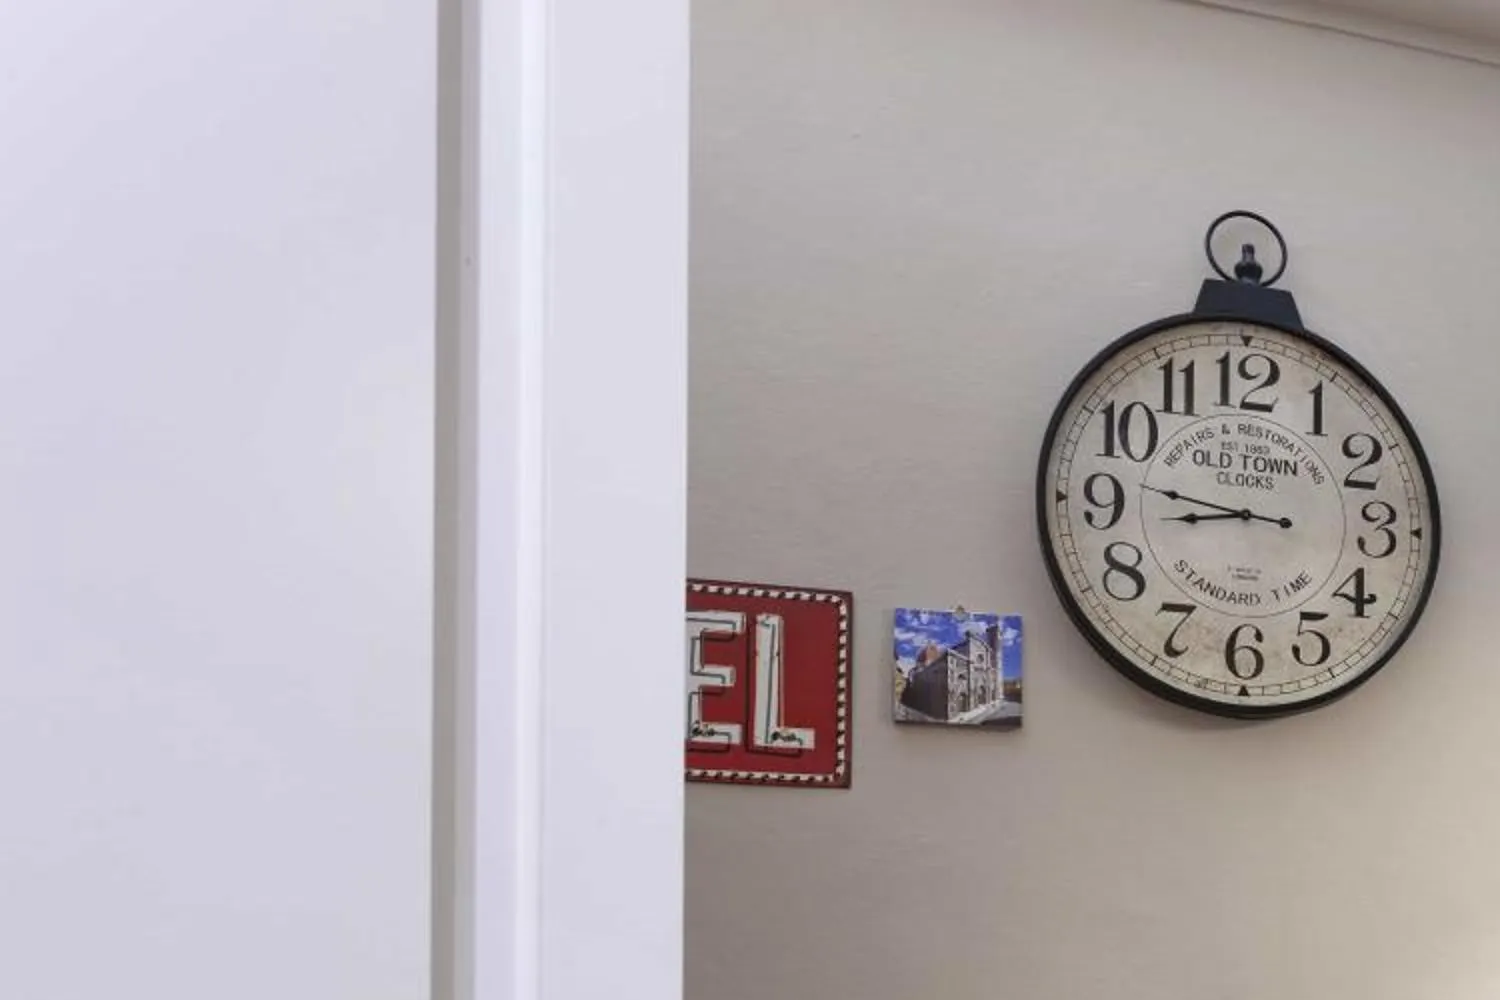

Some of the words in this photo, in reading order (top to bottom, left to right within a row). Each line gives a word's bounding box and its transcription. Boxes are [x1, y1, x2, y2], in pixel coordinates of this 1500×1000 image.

[1156, 357, 1200, 417] 11
[1213, 351, 1280, 414] 12
[1305, 380, 1329, 437] 1
[1096, 400, 1159, 463] 10
[1163, 427, 1216, 468] REPAIRS
[1237, 423, 1325, 486] RESTORATIONS
[1192, 449, 1233, 469] OLD
[1238, 453, 1298, 477] TOWN
[1216, 471, 1275, 490] CLOCKS
[1341, 432, 1383, 490] 2
[1083, 472, 1125, 531] 9
[1356, 500, 1398, 559] 3
[1102, 541, 1147, 602] 8
[1173, 559, 1262, 606] STANDARD
[1270, 570, 1313, 602] TIME
[1331, 567, 1377, 619] 4
[1155, 602, 1198, 658] 7
[1224, 623, 1265, 681] 6
[1291, 611, 1331, 667] 5
